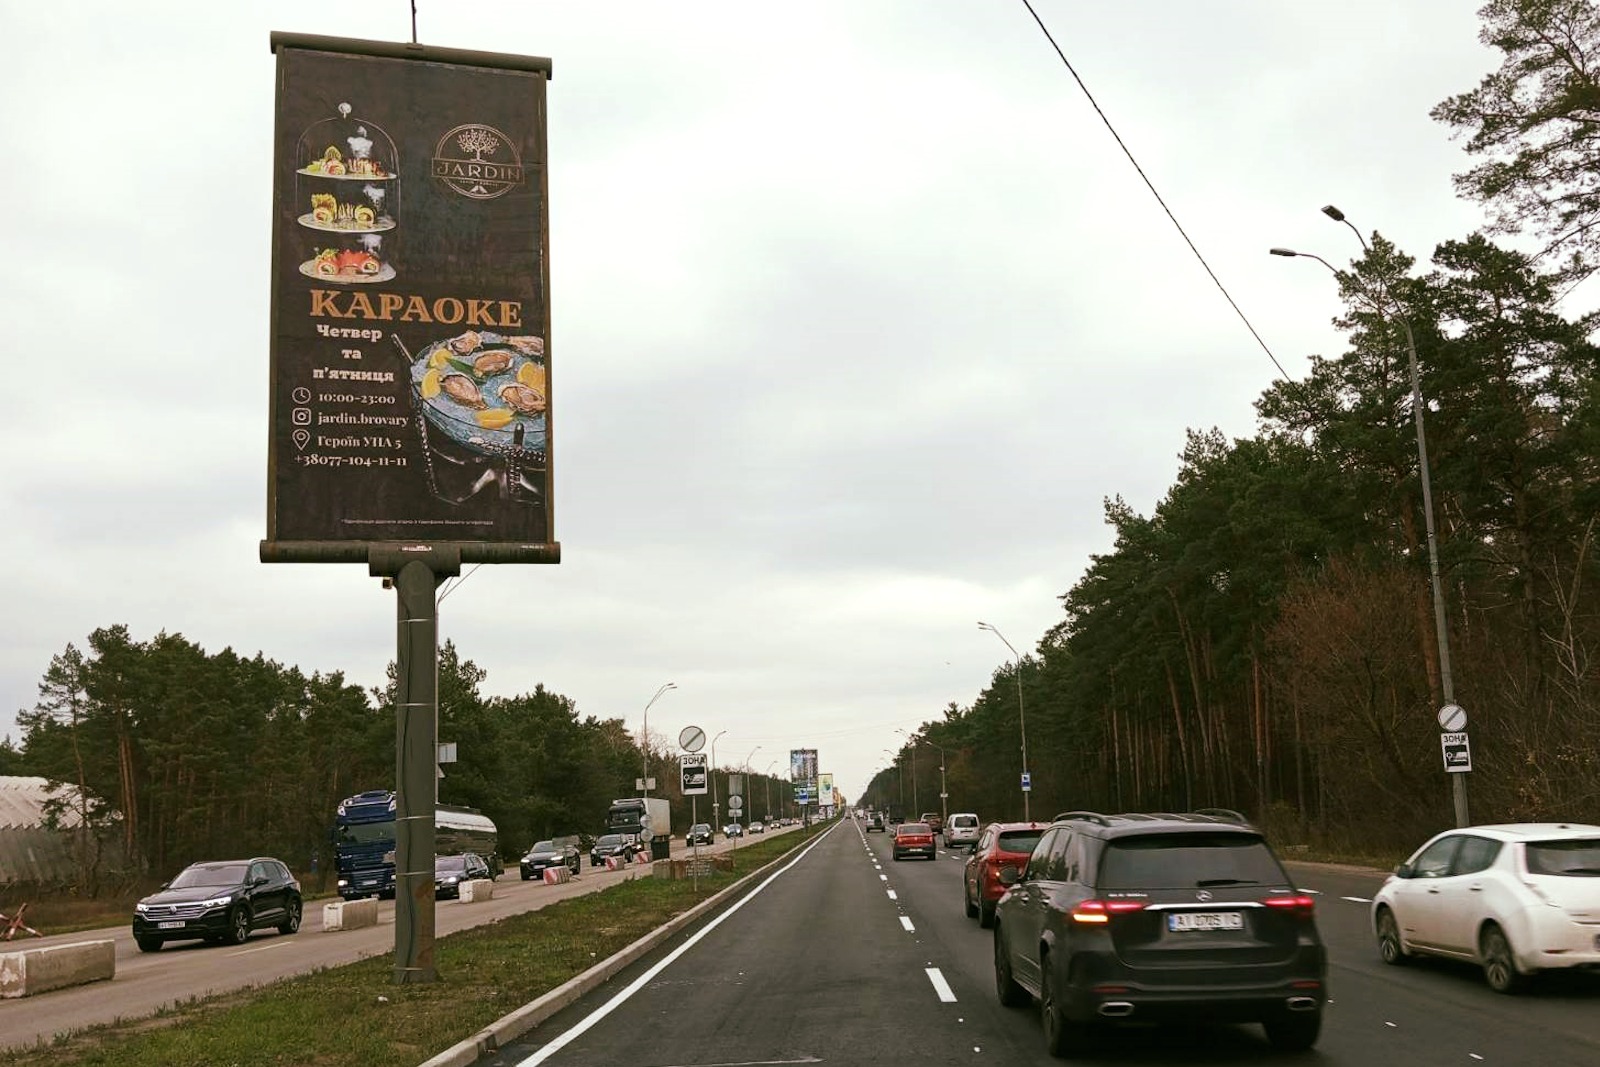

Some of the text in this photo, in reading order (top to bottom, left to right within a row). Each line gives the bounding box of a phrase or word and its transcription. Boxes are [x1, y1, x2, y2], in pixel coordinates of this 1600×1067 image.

[437, 162, 520, 182] JARDIN
[309, 289, 522, 328] КАРАОКЕ
[316, 324, 383, 342] Четвер
[342, 348, 362, 360] та
[312, 366, 395, 384] п'ятниця
[318, 393, 396, 405] 10:00-23:00
[317, 412, 410, 428] jardin.brovary
[317, 435, 402, 450] Героїв УПА 5
[294, 453, 407, 467] +38077-104-11-11
[1443, 735, 1466, 743] ЗОНА
[683, 756, 705, 765] ЗОНА
